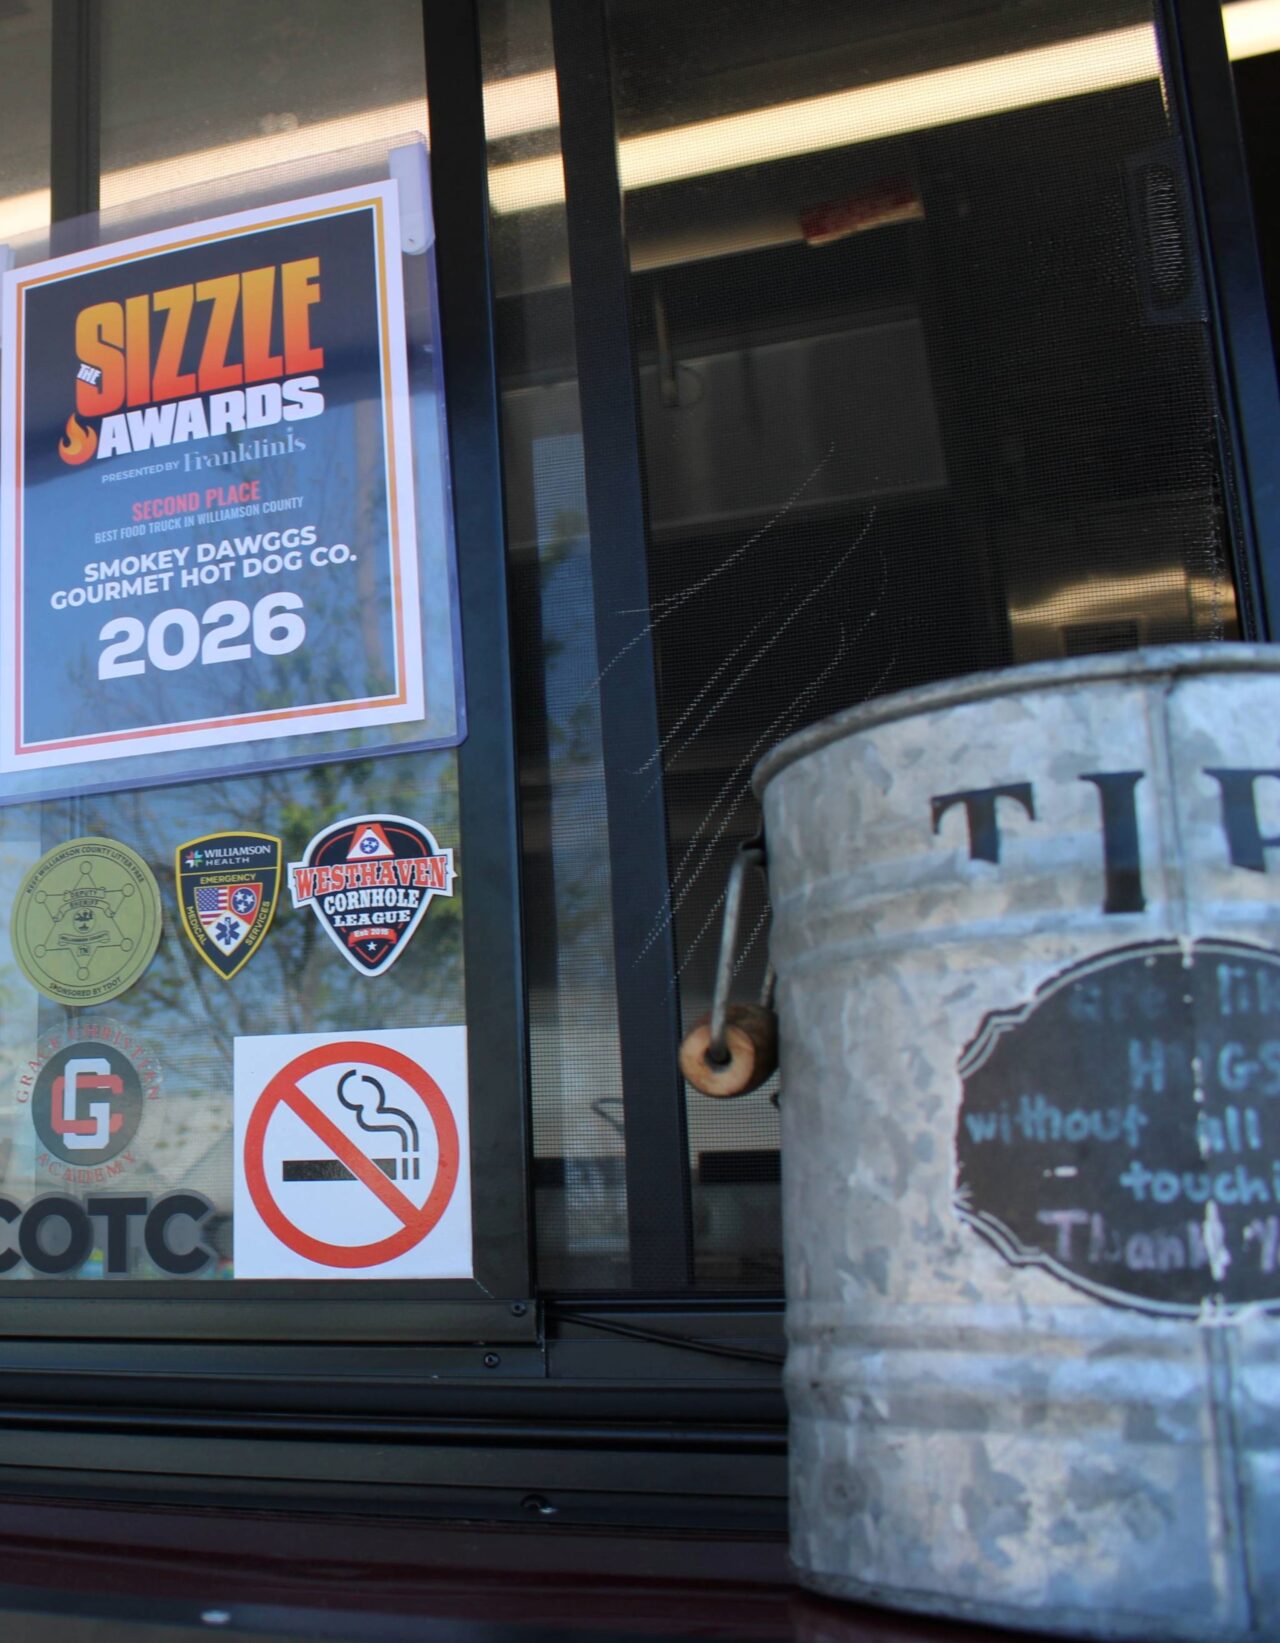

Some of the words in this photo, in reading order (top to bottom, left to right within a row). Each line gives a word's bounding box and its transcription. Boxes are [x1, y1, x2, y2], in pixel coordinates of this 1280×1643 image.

[75, 257, 324, 417] SIZZLE
[77, 363, 102, 385] THE
[96, 375, 325, 460] AWARDS
[102, 463, 164, 484] PRESENTED
[166, 460, 181, 472] BY
[94, 530, 119, 545] BEST
[119, 524, 147, 540] FOOD
[148, 519, 182, 535] TRUCK
[184, 515, 195, 527] IN
[197, 506, 260, 525] WILLIAMSON
[262, 496, 304, 514] COUNTY
[131, 491, 200, 523] SECOND
[205, 480, 261, 509] PLACE
[83, 545, 190, 584] SMOKEY
[196, 525, 318, 563] DAWGGS
[50, 572, 174, 610] GOURMET
[180, 561, 236, 590] HOT
[242, 549, 303, 580] DOG
[310, 543, 358, 568] CO.
[97, 591, 306, 681] 2026
[39, 848, 81, 876] WILLIAMSON
[81, 846, 110, 856] COUNTY
[204, 845, 271, 859] WILLIAMSON
[206, 857, 250, 867] HEALTH
[200, 873, 257, 885] EMERGENCY
[294, 855, 447, 901] WESTHAVEN
[324, 887, 421, 915] CORNHOLE
[333, 910, 412, 927] LEAGUE
[186, 906, 208, 946] MEDICAL
[245, 901, 271, 946] SERVICES
[49, 982, 91, 997] SPONSORED
[93, 987, 102, 996] BY
[103, 976, 122, 992] TDOT
[965, 1093, 1149, 1148] without
